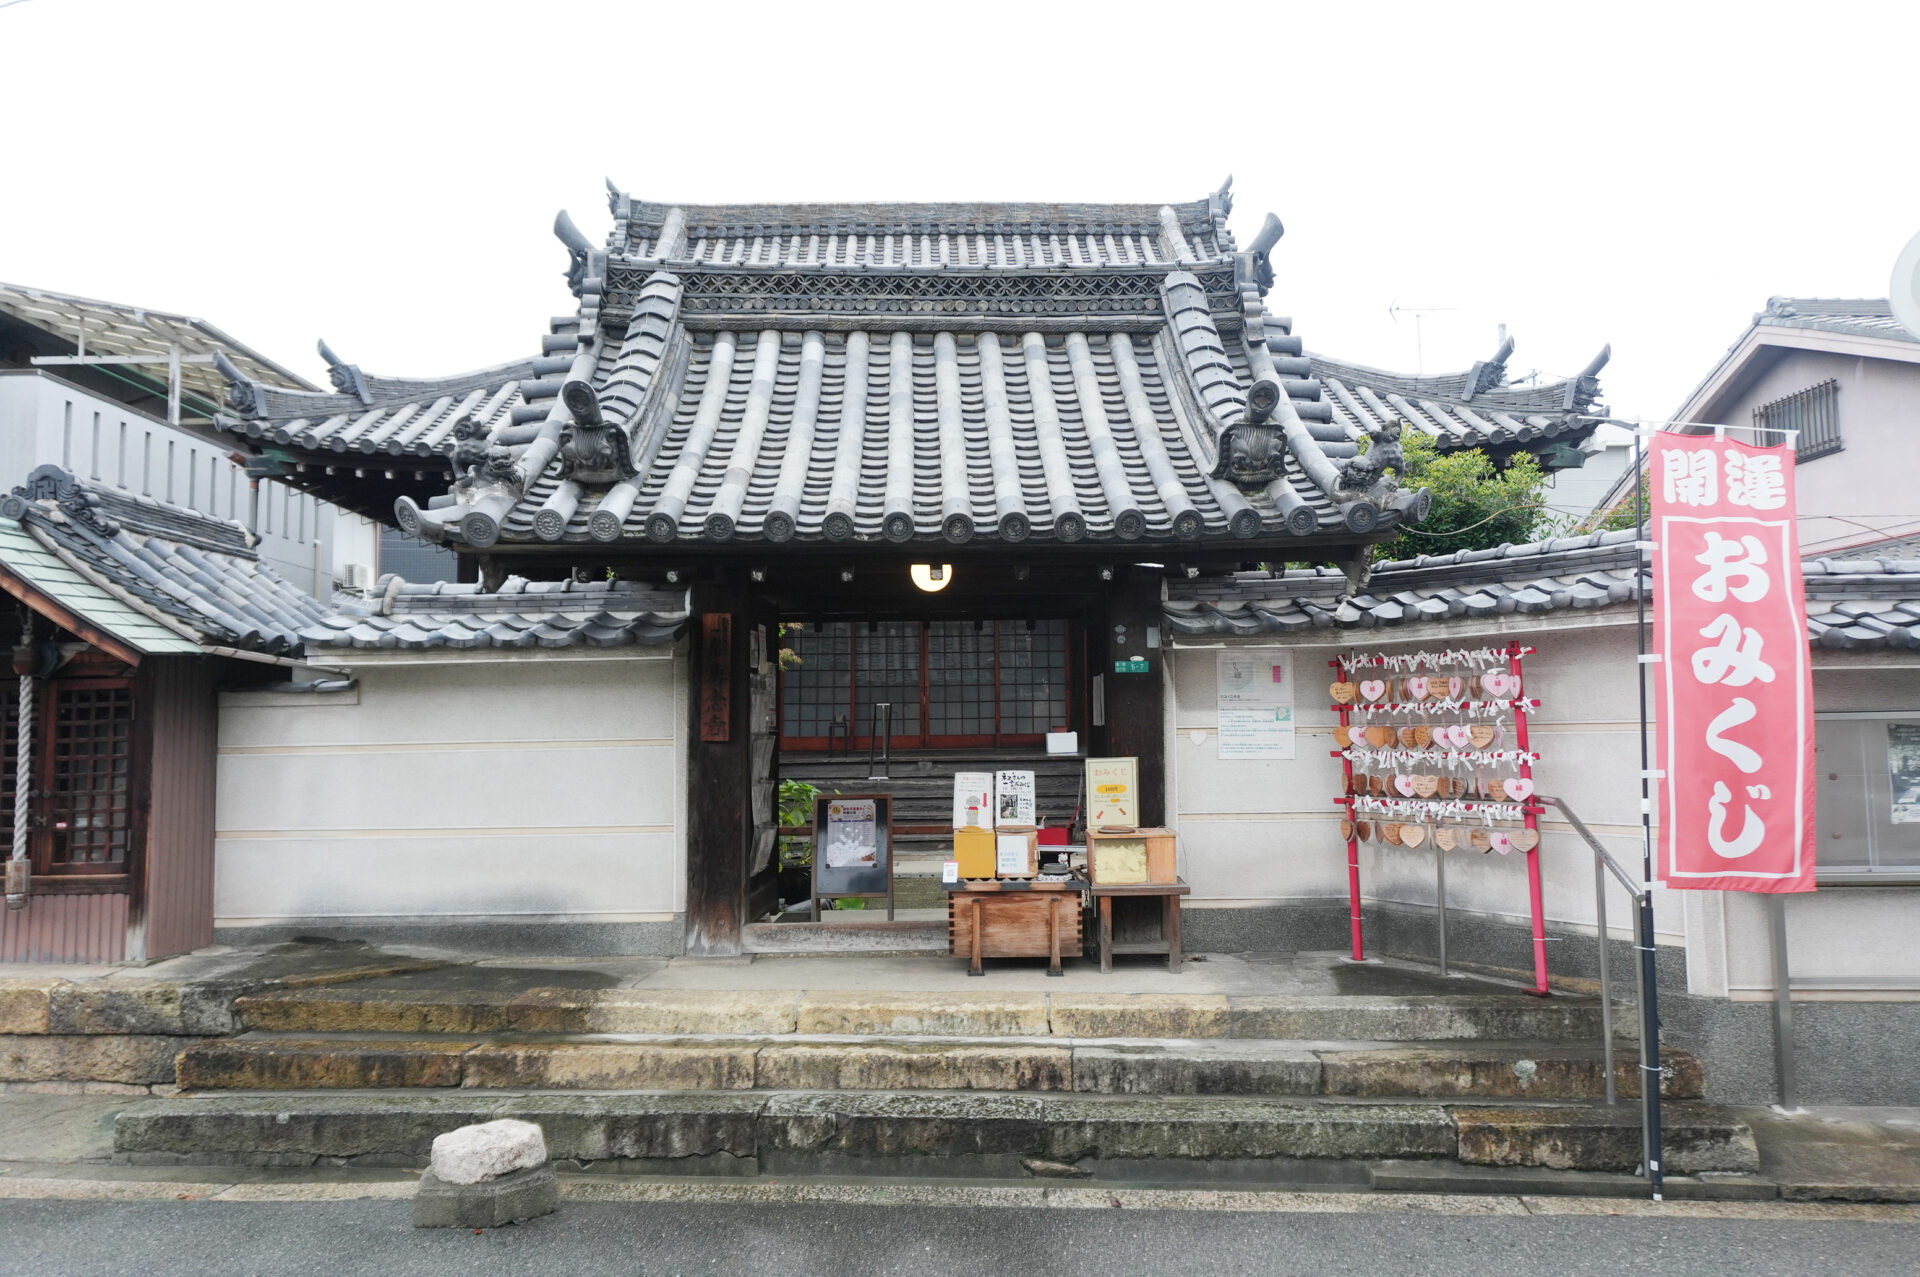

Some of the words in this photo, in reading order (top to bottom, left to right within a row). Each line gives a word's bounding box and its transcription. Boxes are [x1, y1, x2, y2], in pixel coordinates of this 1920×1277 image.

[1661, 449, 1787, 510] 開運
[1692, 531, 1776, 859] おみくじ
